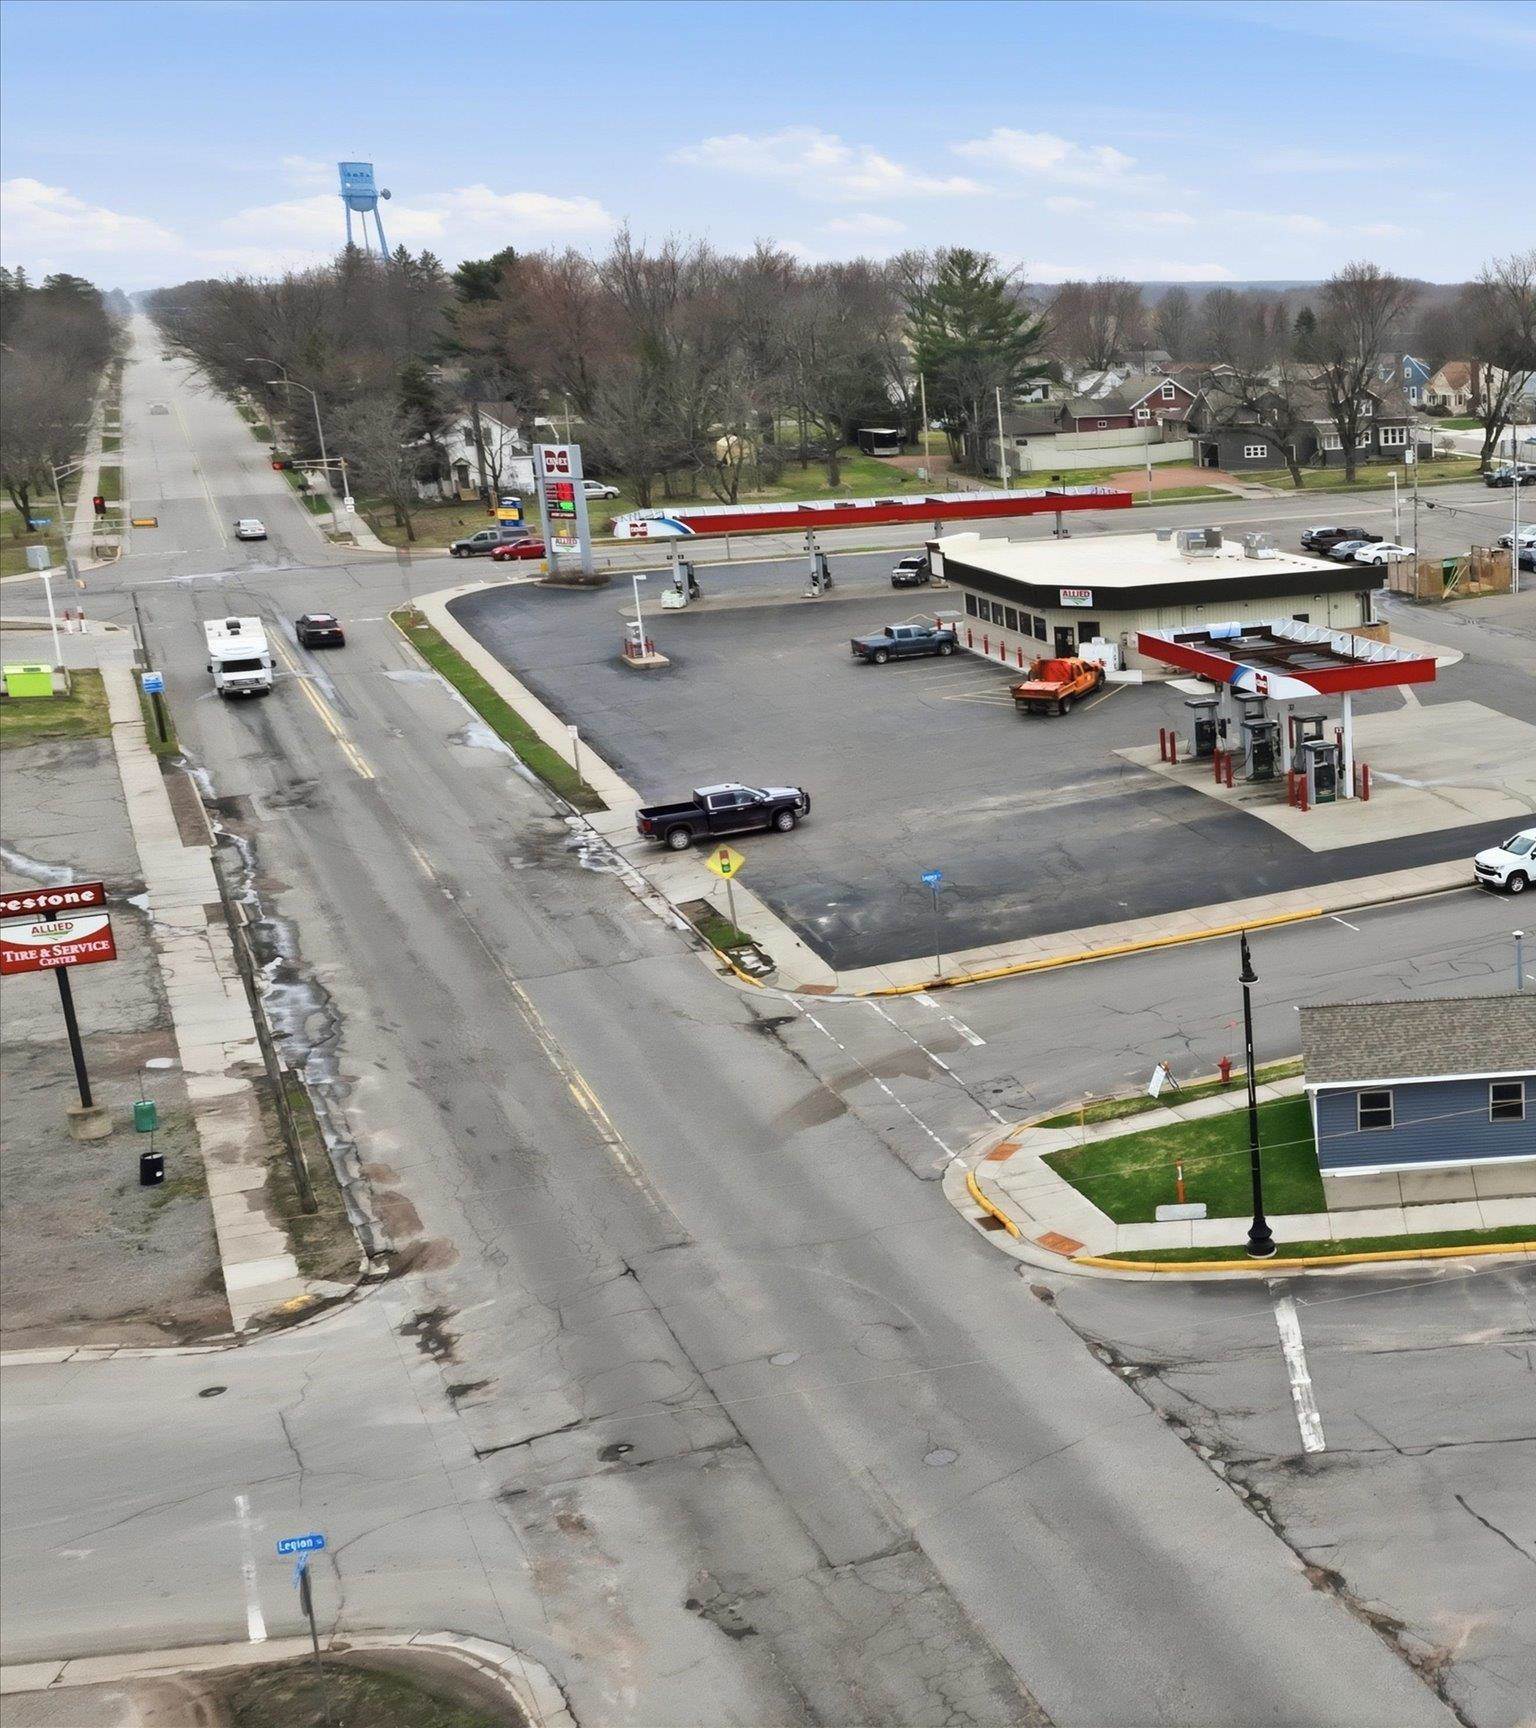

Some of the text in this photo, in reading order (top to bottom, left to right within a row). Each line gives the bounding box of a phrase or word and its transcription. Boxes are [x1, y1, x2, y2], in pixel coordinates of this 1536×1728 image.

[31, 921, 74, 935] ALLIED
[3, 940, 111, 963] TIRE & SERVICE
[39, 955, 78, 966] CENTER
[278, 1538, 314, 1551] Legion
